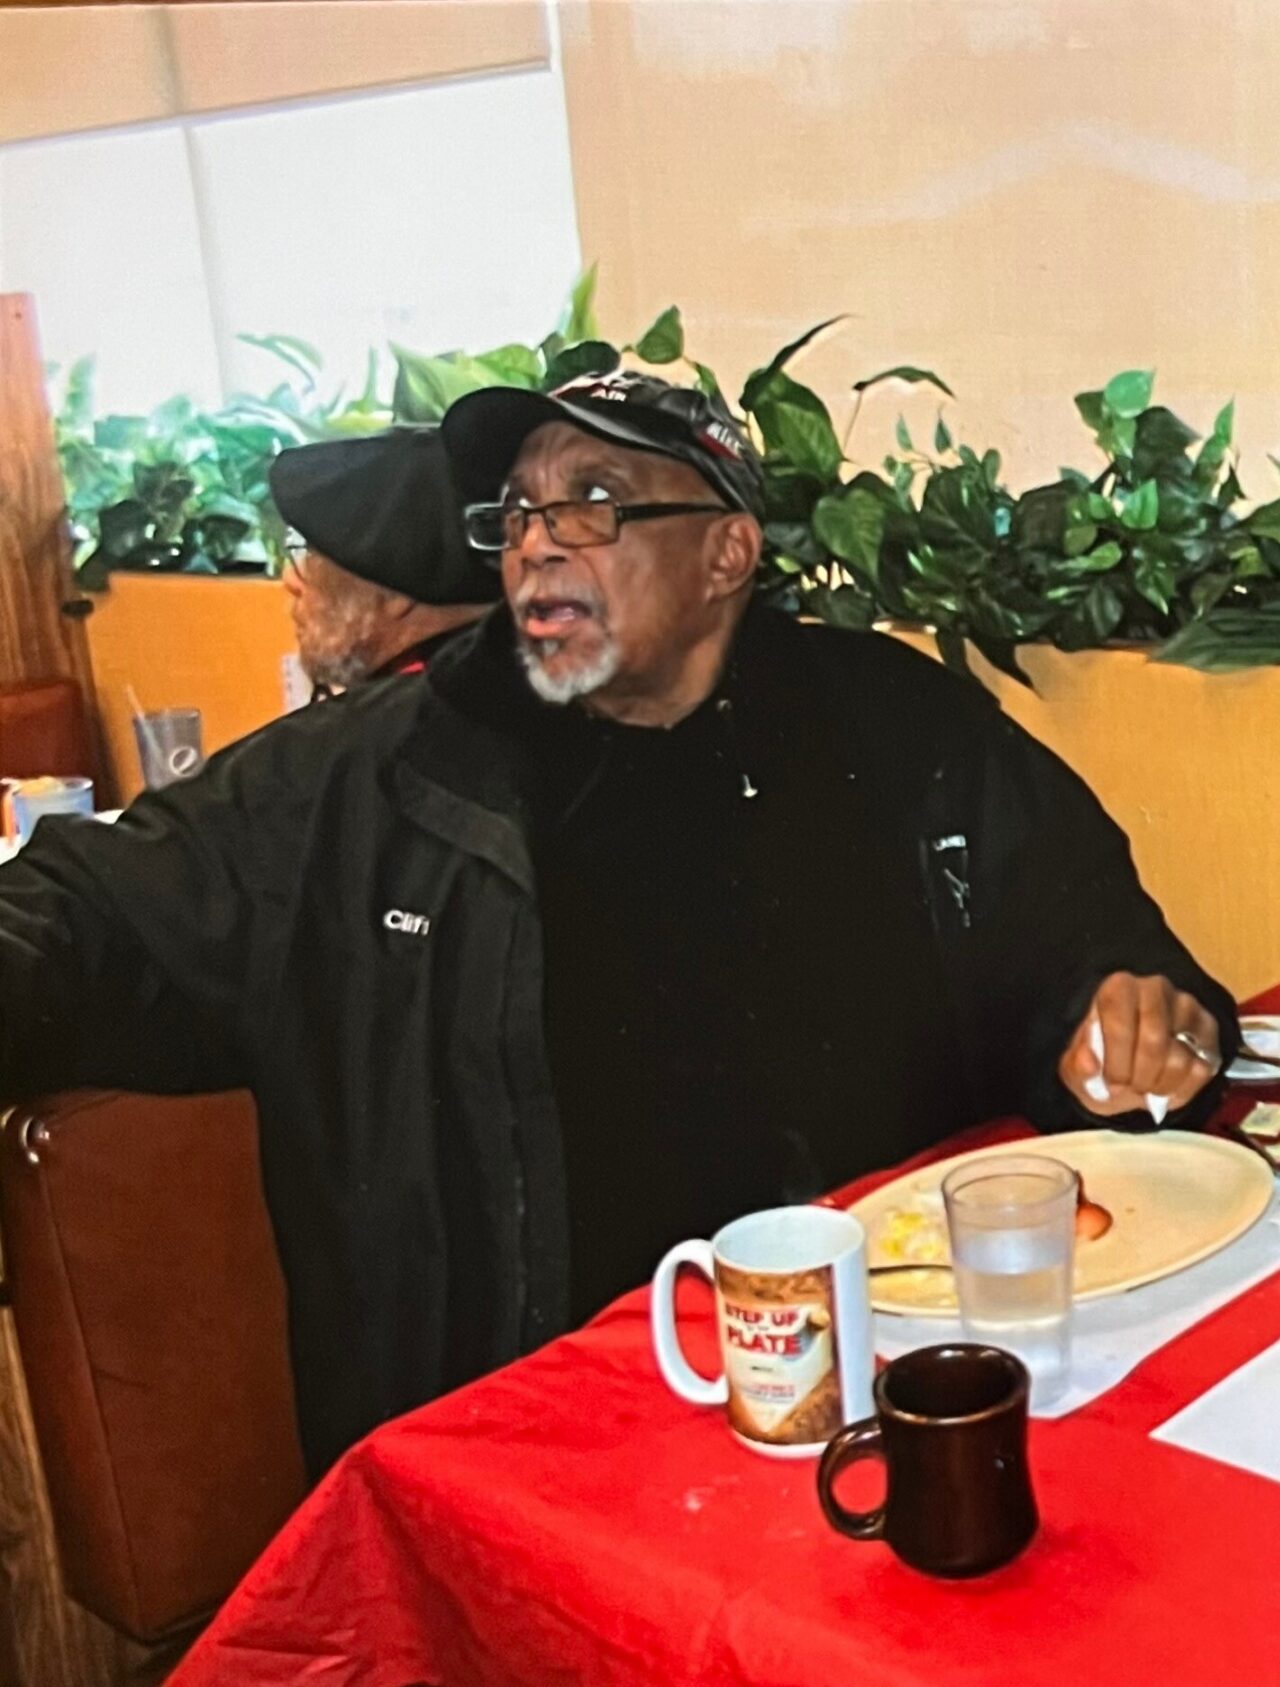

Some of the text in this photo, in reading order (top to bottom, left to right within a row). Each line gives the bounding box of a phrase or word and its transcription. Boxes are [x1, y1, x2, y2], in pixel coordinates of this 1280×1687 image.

[725, 1302, 798, 1327] STEP UP
[727, 1324, 801, 1356] PLATE
